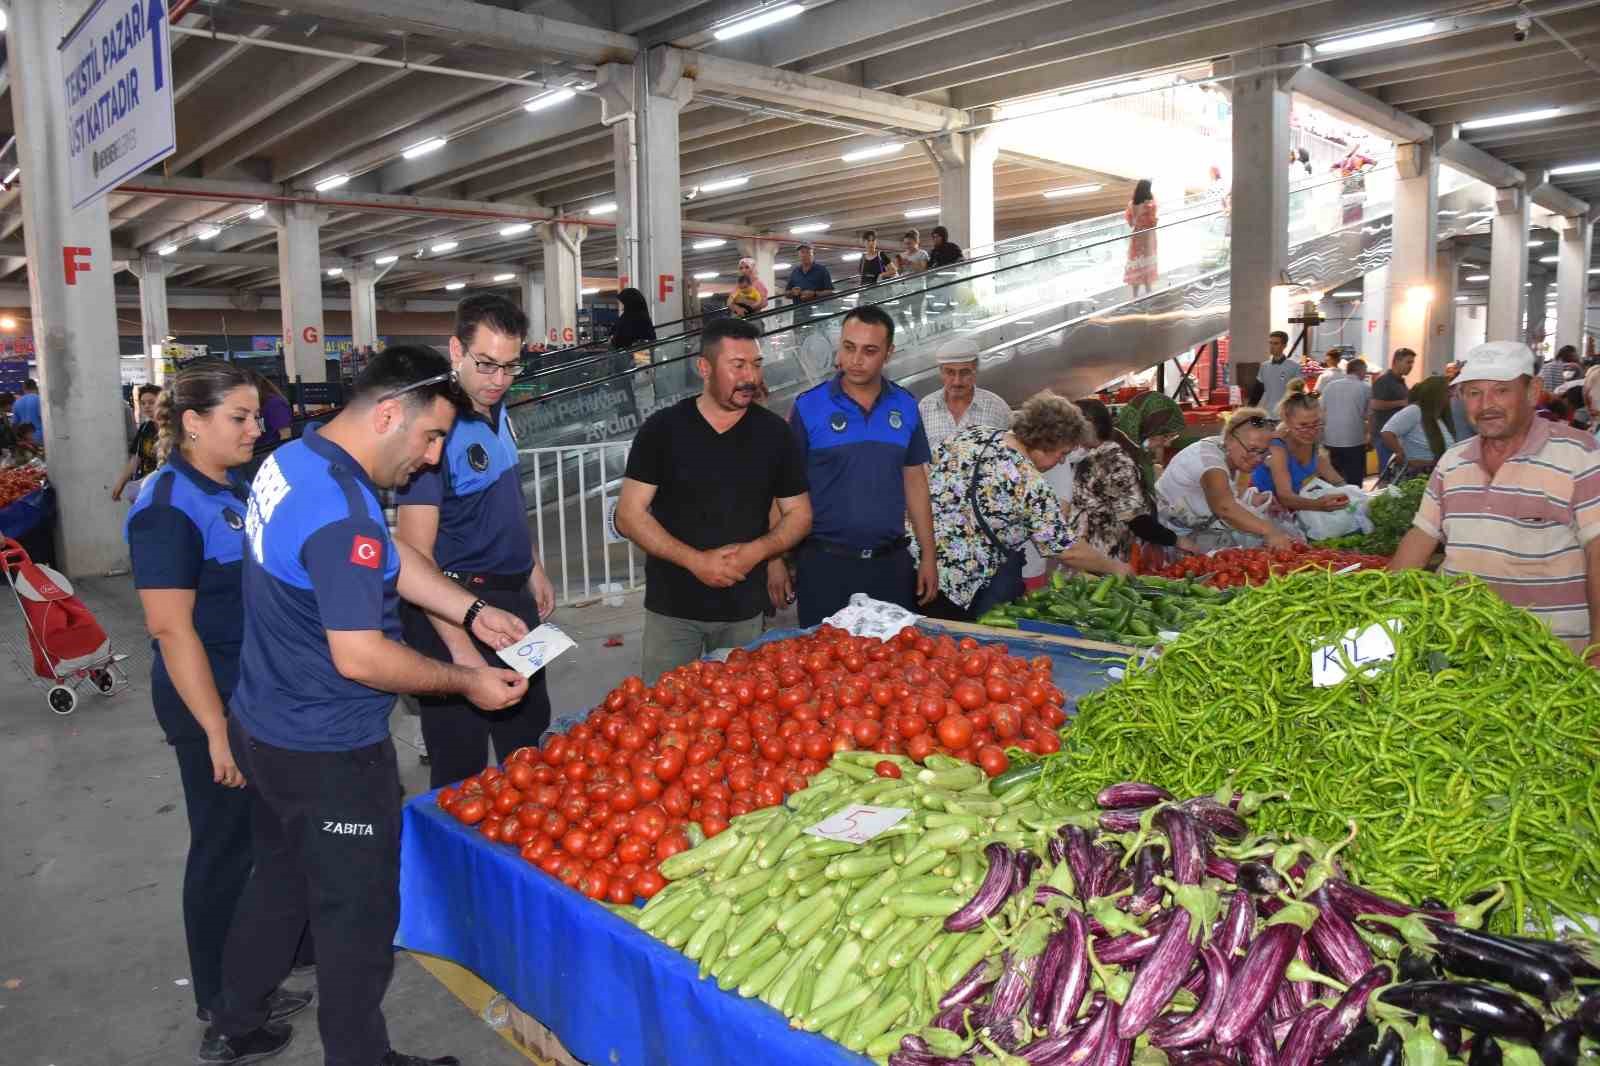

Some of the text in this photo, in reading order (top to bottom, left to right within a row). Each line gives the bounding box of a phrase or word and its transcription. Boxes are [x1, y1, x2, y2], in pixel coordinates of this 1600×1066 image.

[65, 0, 145, 108] TEKSTİL PAZARI
[86, 67, 140, 145] KATTADIR
[63, 246, 91, 285] F
[659, 275, 674, 302] F
[303, 327, 319, 344] G
[562, 327, 575, 342] G
[585, 413, 637, 443] Aydın
[321, 821, 375, 836] ZABITA
[817, 810, 878, 835] 5
